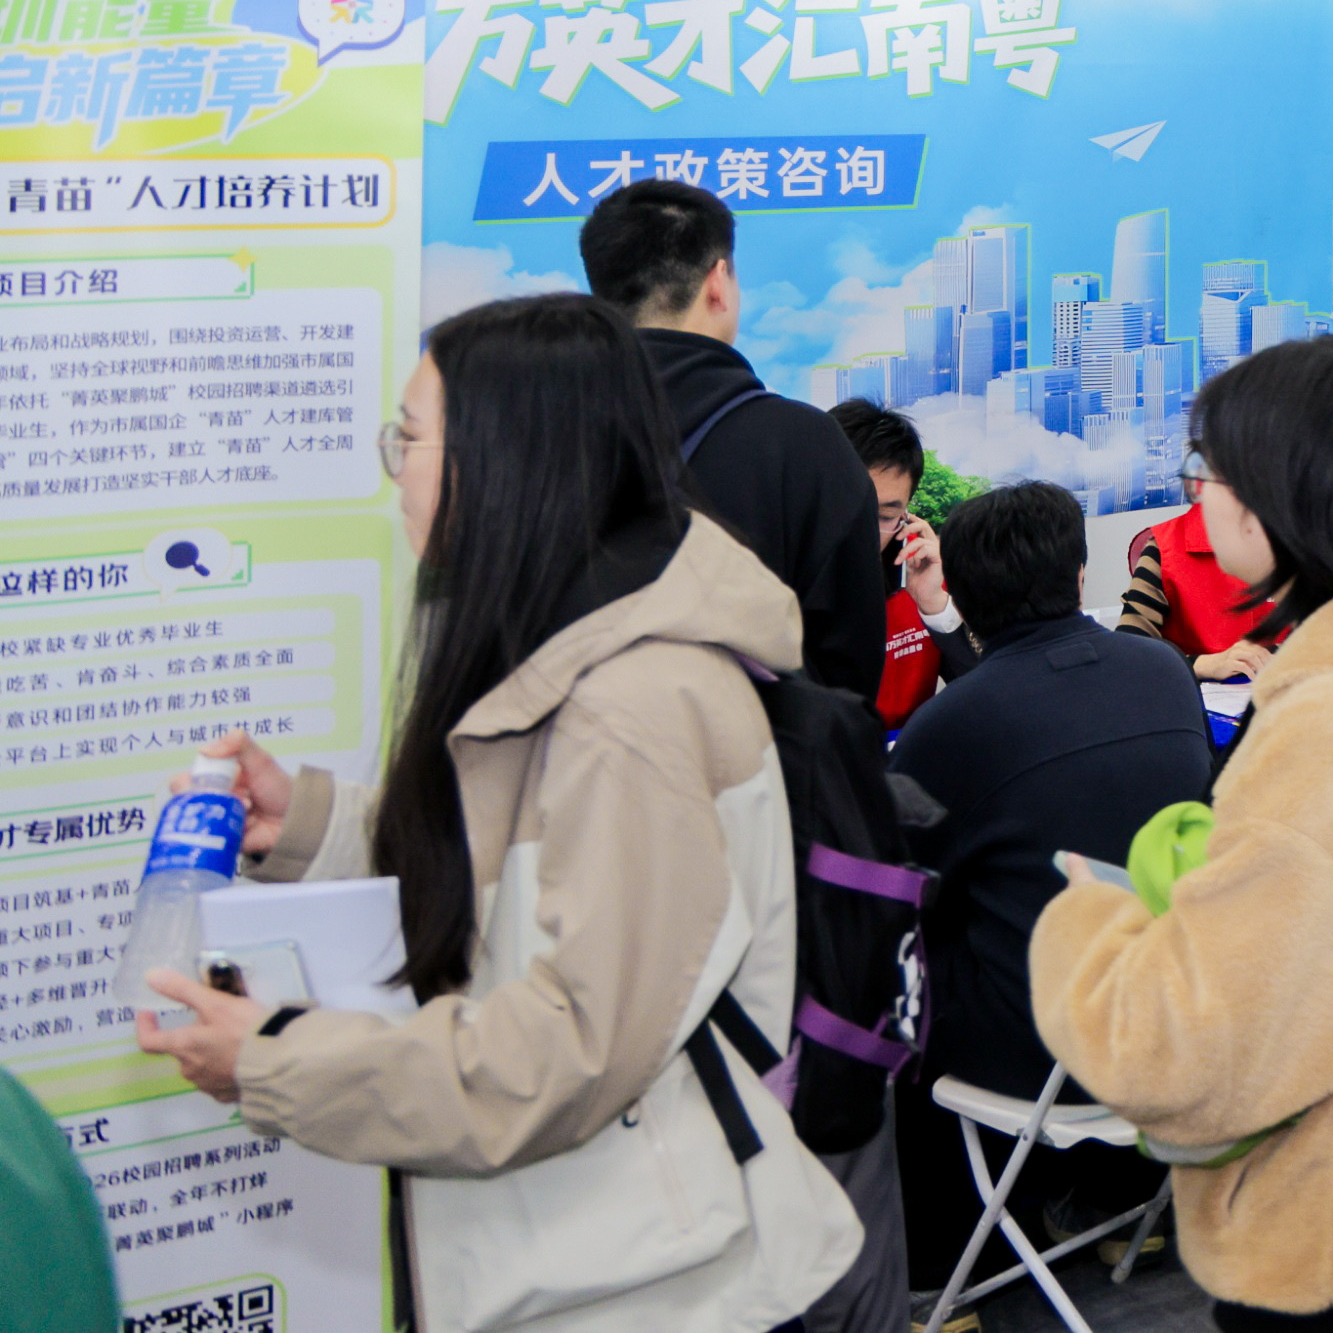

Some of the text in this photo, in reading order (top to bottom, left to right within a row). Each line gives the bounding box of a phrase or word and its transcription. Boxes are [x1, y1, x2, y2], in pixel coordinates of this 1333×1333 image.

[0, 648, 294, 693] 吃苦、肯奋斗、综合素质全面
[0, 686, 251, 729] 意识和团结协作能力较强
